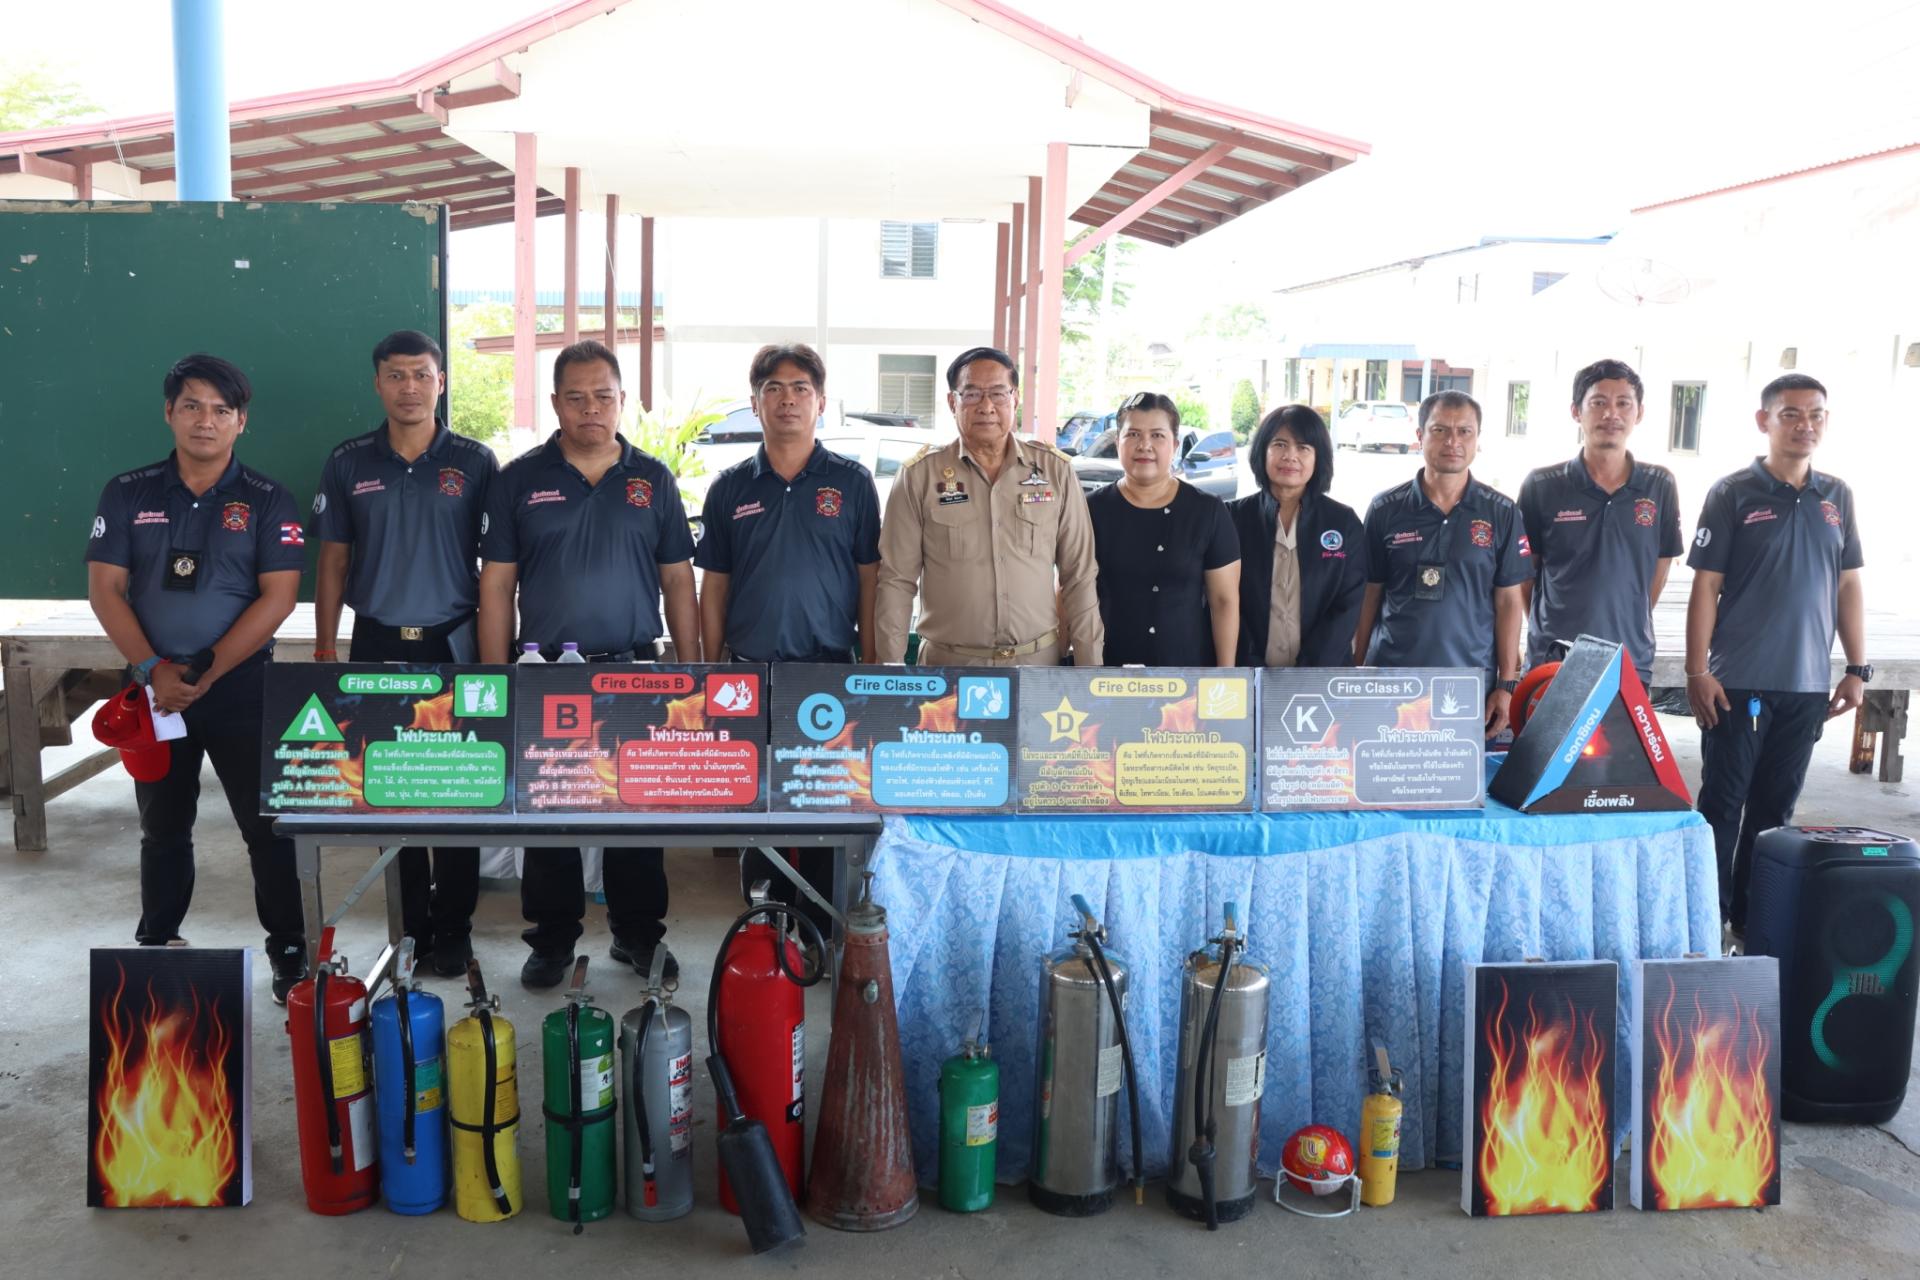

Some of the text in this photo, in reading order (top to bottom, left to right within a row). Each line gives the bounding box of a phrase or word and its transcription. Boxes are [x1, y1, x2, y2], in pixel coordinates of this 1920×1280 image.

[348, 677, 433, 690] Fire Class A
[601, 677, 684, 690] Fire Class B
[854, 679, 937, 691] Fire Class C
[1098, 681, 1178, 693] Fire Class D
[1337, 682, 1413, 694] Fire Class K
[299, 708, 326, 735] A
[556, 703, 579, 729] B
[810, 703, 833, 730] C
[1056, 712, 1074, 733] D
[1296, 706, 1319, 733] K
[394, 727, 478, 743] ไฟประเภท A
[647, 727, 730, 742] ไฟประเภท B
[899, 727, 982, 744] ไฟประเภท C
[1142, 729, 1220, 744] ไฟประเภท D
[1379, 728, 1455, 743] ไฟประเภท K
[1564, 708, 1600, 763] ออกซิเจน
[1634, 705, 1664, 762] ความร้อน
[295, 783, 304, 792] A
[552, 782, 559, 790] B
[805, 781, 813, 790] C
[1584, 790, 1634, 807] เชื้อเพลิง
